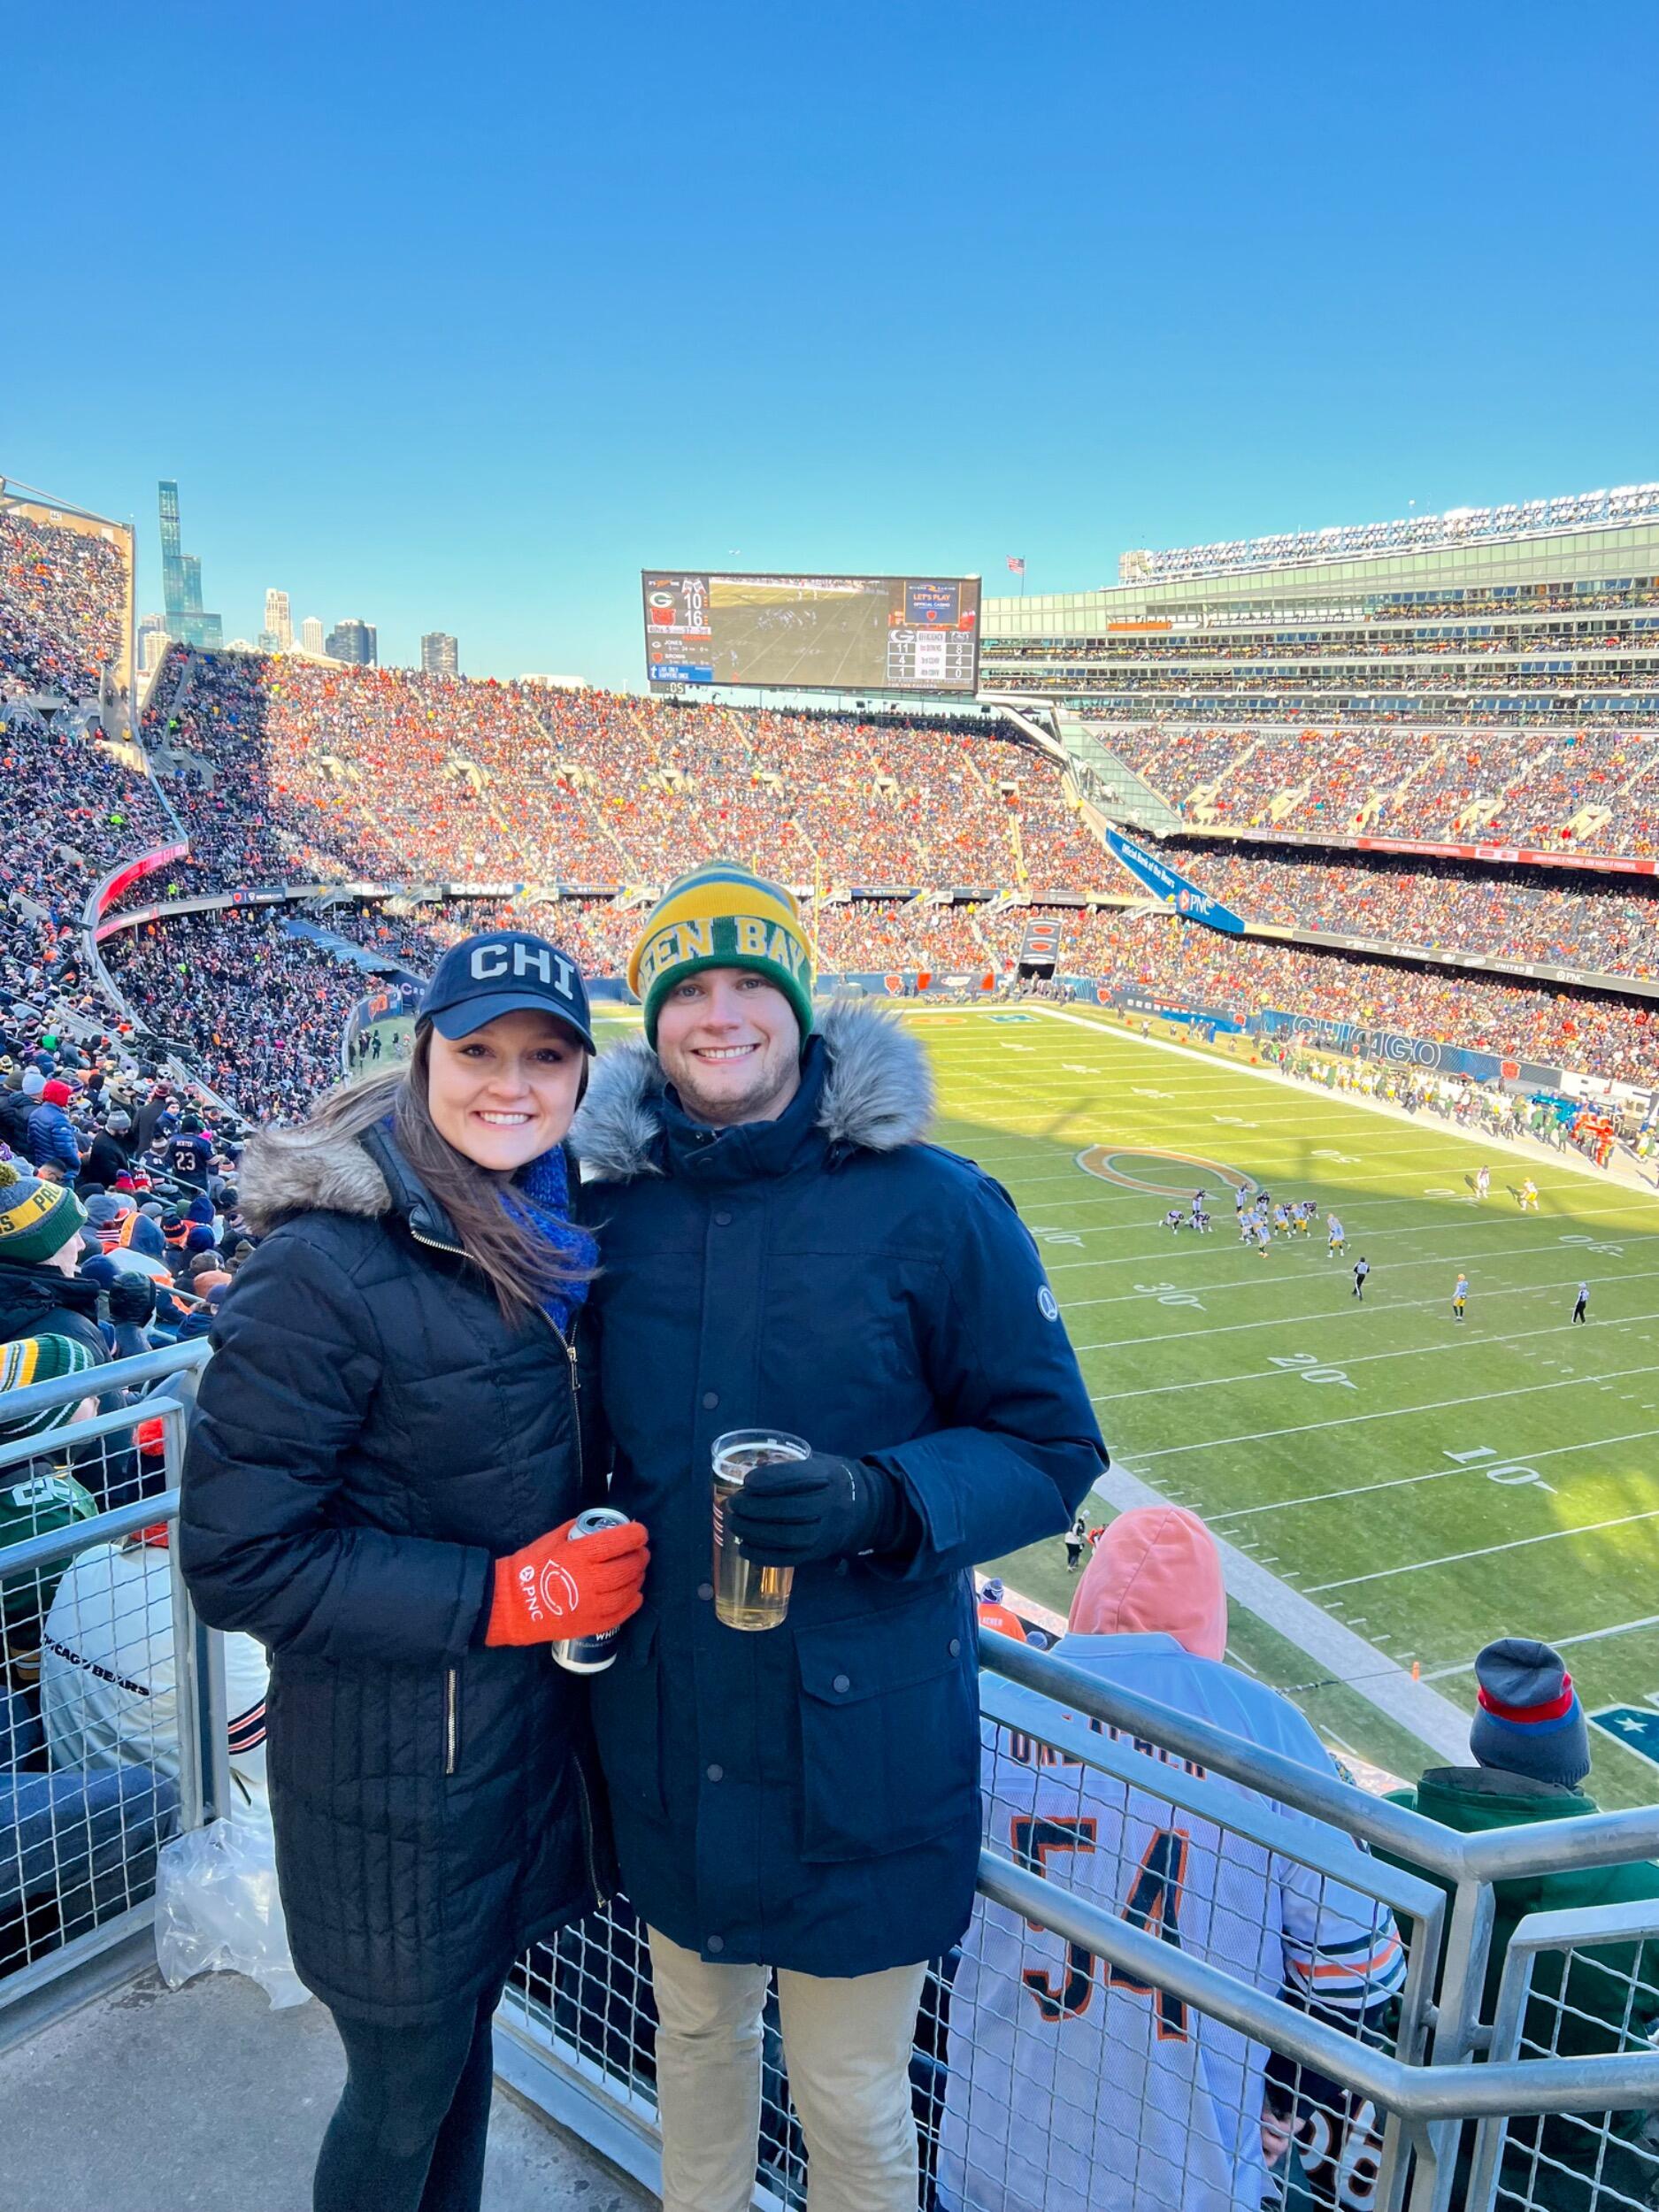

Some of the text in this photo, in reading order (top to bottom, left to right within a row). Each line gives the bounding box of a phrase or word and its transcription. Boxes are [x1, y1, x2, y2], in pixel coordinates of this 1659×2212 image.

[684, 593, 702, 610] 10
[685, 610, 703, 626] 16
[897, 643, 908, 653] 11
[956, 645, 963, 654] 8
[899, 655, 906, 664] 4
[956, 657, 963, 665] 4
[899, 668, 904, 677] 1
[956, 669, 962, 678] 0
[450, 883, 514, 895] DOWN
[1190, 894, 1210, 916] PNC
[734, 916, 806, 982] BAY
[471, 942, 575, 1000] CHI
[1494, 962, 1525, 972] UNITED
[1566, 972, 1586, 983] PNC
[175, 1151, 196, 1171] 23
[1133, 1282, 1200, 1307] 30
[1266, 1352, 1349, 1384] 20
[1442, 1445, 1541, 1486] 10
[522, 1586, 544, 1622] PNC
[44, 1633, 150, 1696] HICAGO BEARS
[1010, 1816, 1189, 2043] 54
